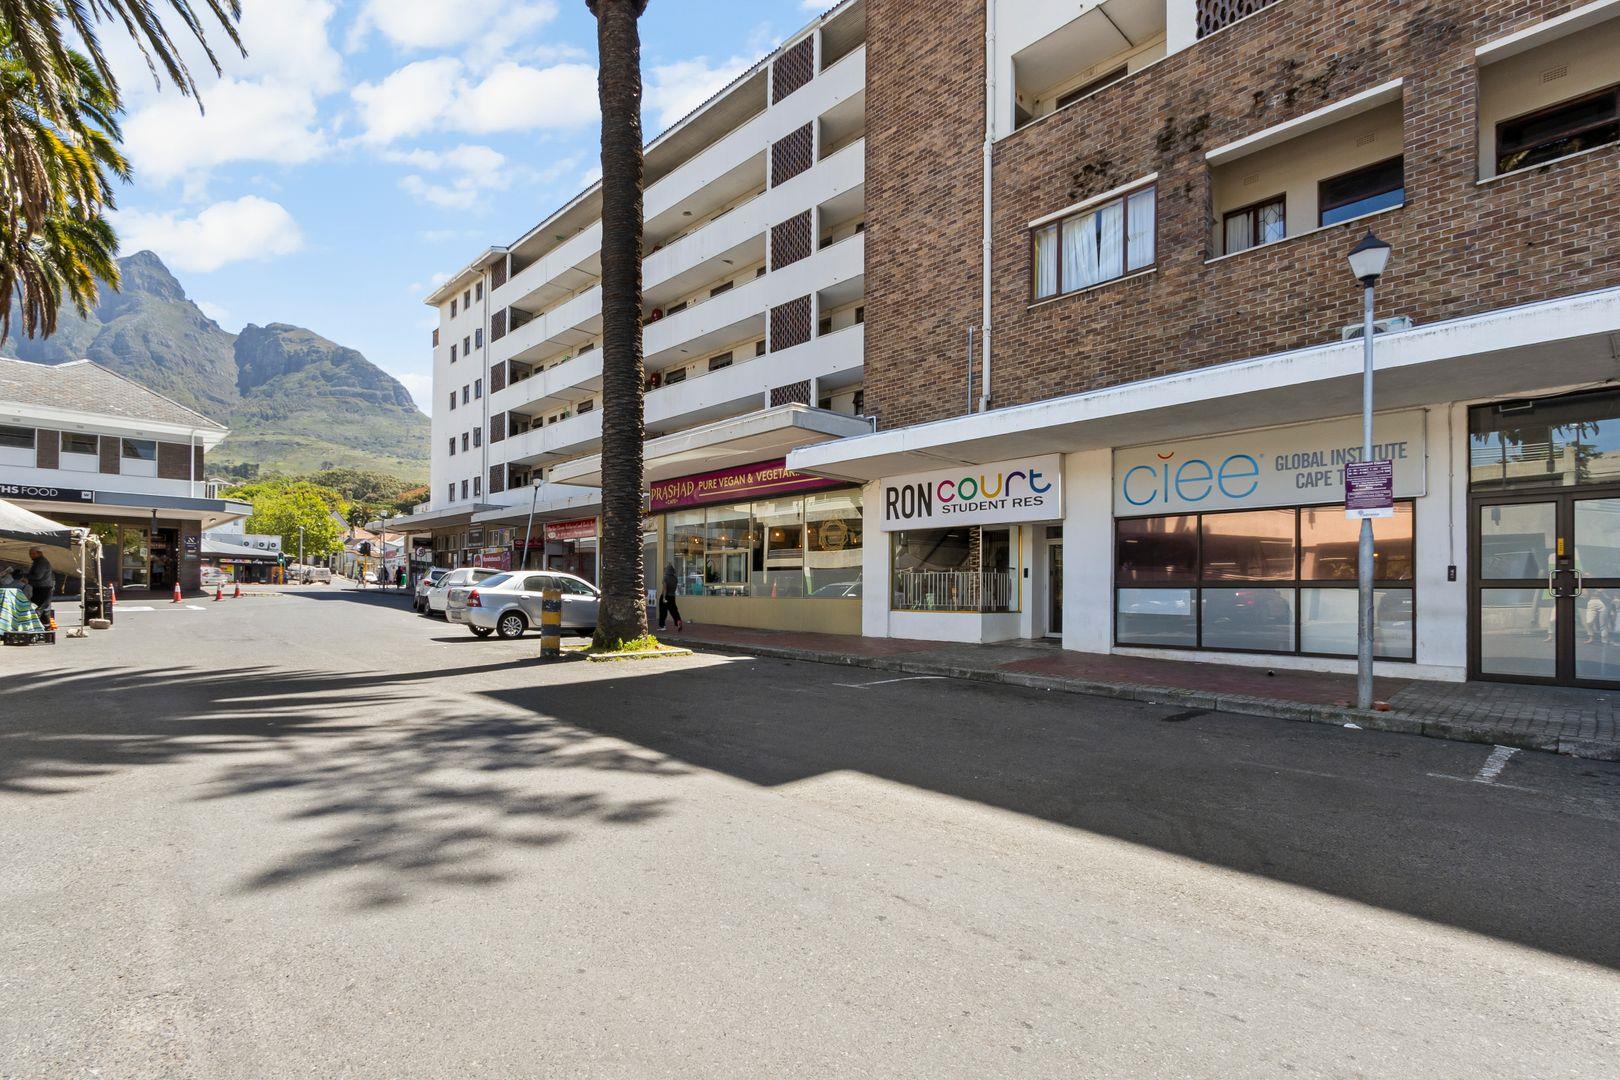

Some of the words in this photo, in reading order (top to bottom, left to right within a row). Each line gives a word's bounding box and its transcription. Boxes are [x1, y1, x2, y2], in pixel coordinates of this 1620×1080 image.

[1275, 452, 1327, 471] GLOBAL
[1331, 441, 1408, 466] INSTTUTE
[651, 481, 695, 501] PRASHAD
[698, 478, 717, 490] PURE
[718, 473, 746, 488] VEGAN
[747, 472, 754, 483] &
[1123, 452, 1259, 506] ciee
[1296, 470, 1332, 489] CAPE
[21, 486, 58, 497] FOOD
[942, 499, 1007, 514] STUDENT
[1012, 496, 1044, 508] RES
